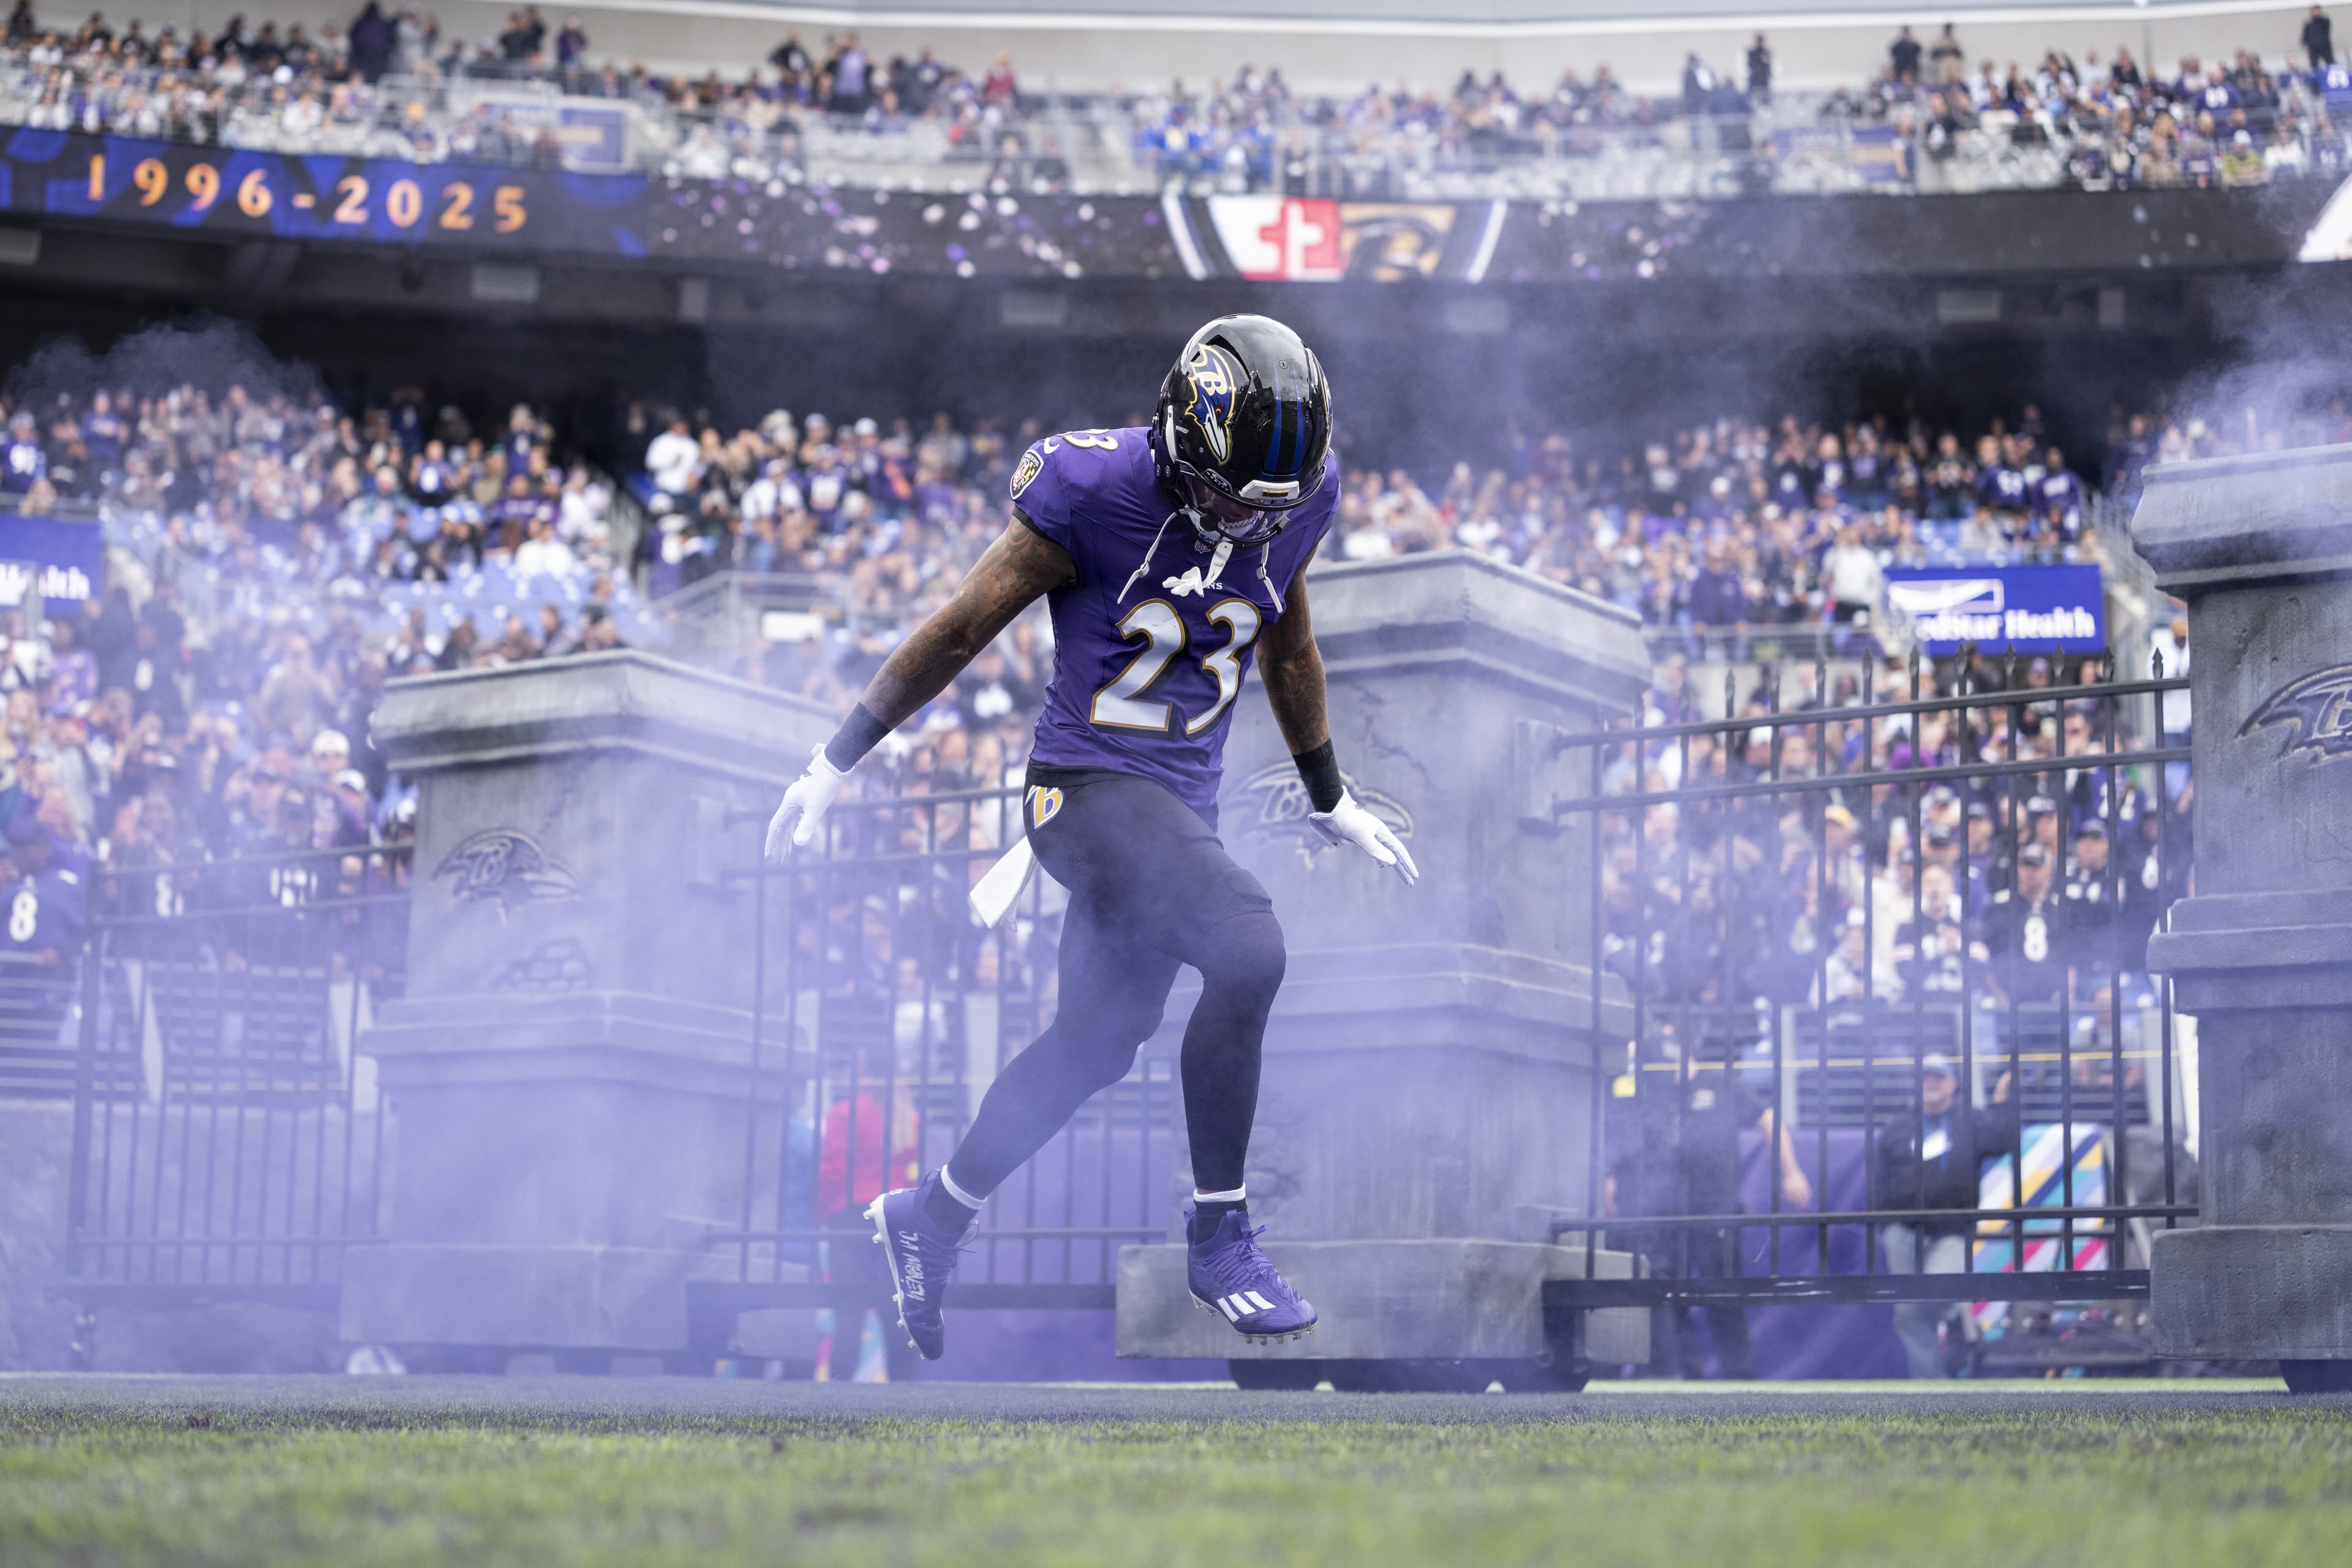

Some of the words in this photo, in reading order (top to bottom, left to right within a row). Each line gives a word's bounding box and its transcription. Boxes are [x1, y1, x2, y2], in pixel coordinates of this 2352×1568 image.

[88, 153, 527, 233] 1996-2025
[2005, 606, 2095, 639] Health
[1090, 597, 1262, 739] 23
[9, 890, 38, 941] 8
[2023, 916, 2048, 962] 8
